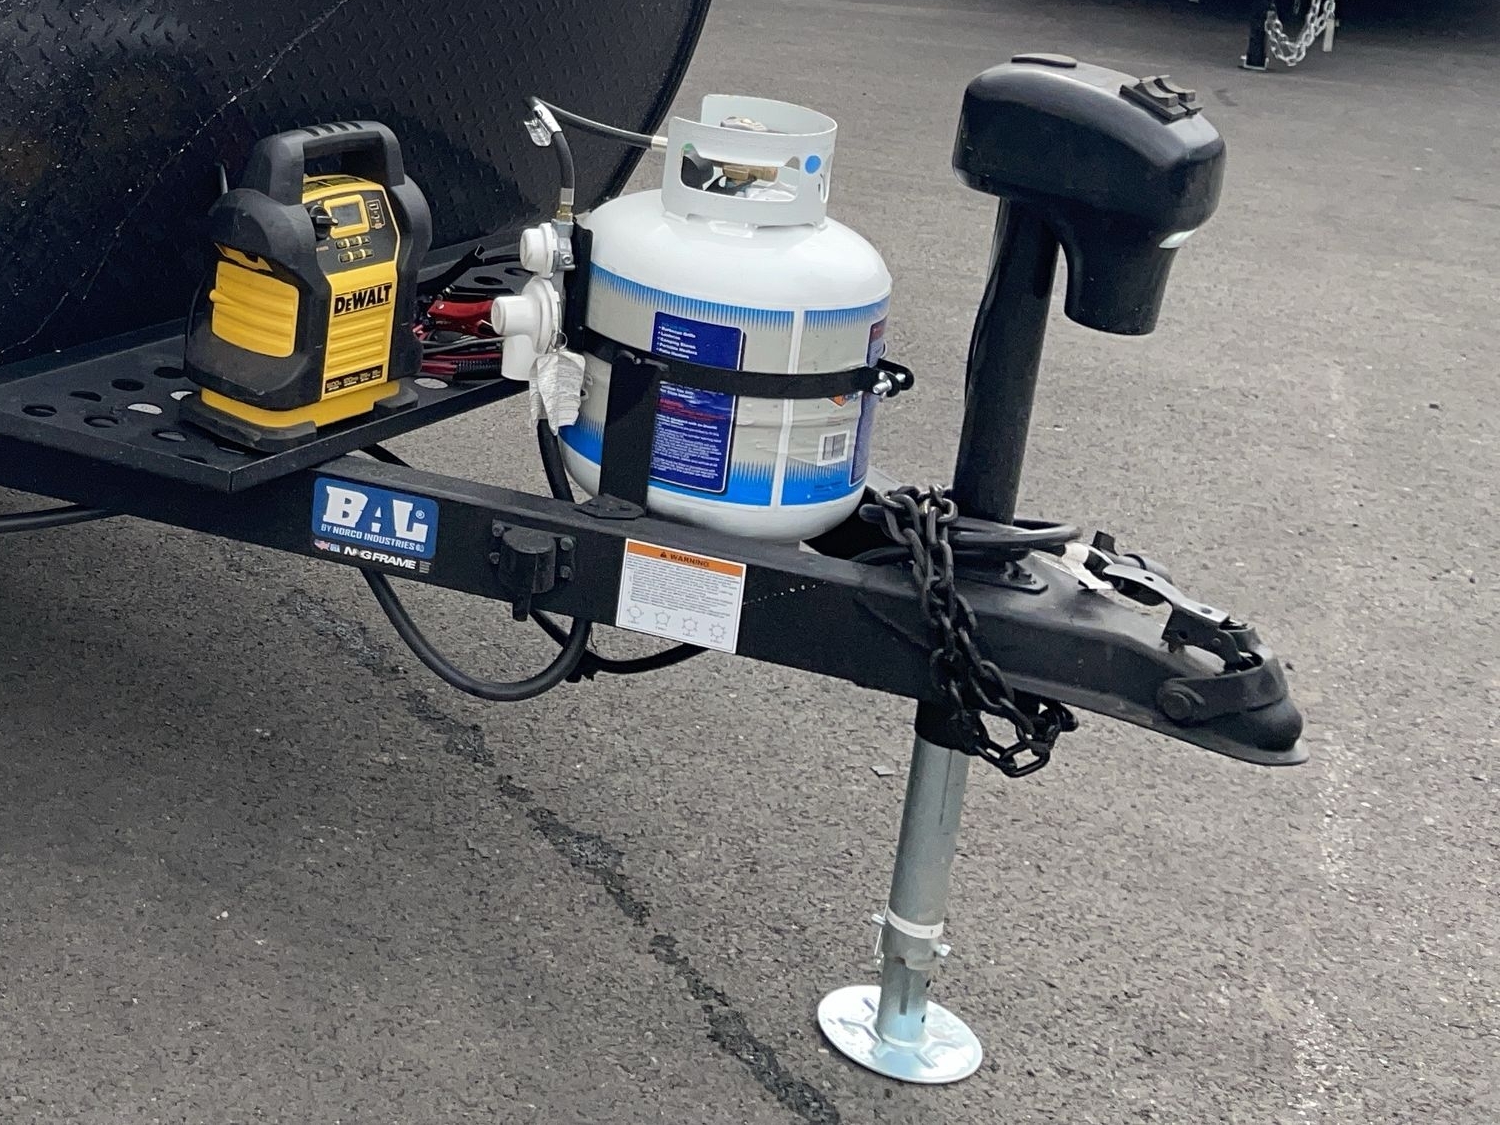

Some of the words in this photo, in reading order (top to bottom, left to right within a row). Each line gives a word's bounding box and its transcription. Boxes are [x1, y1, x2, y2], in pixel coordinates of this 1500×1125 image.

[322, 485, 429, 543] BAL
[320, 523, 331, 533] BY
[332, 526, 362, 539] NORCO
[364, 533, 416, 552] INDUSTRIES
[670, 554, 710, 568] WARNING
